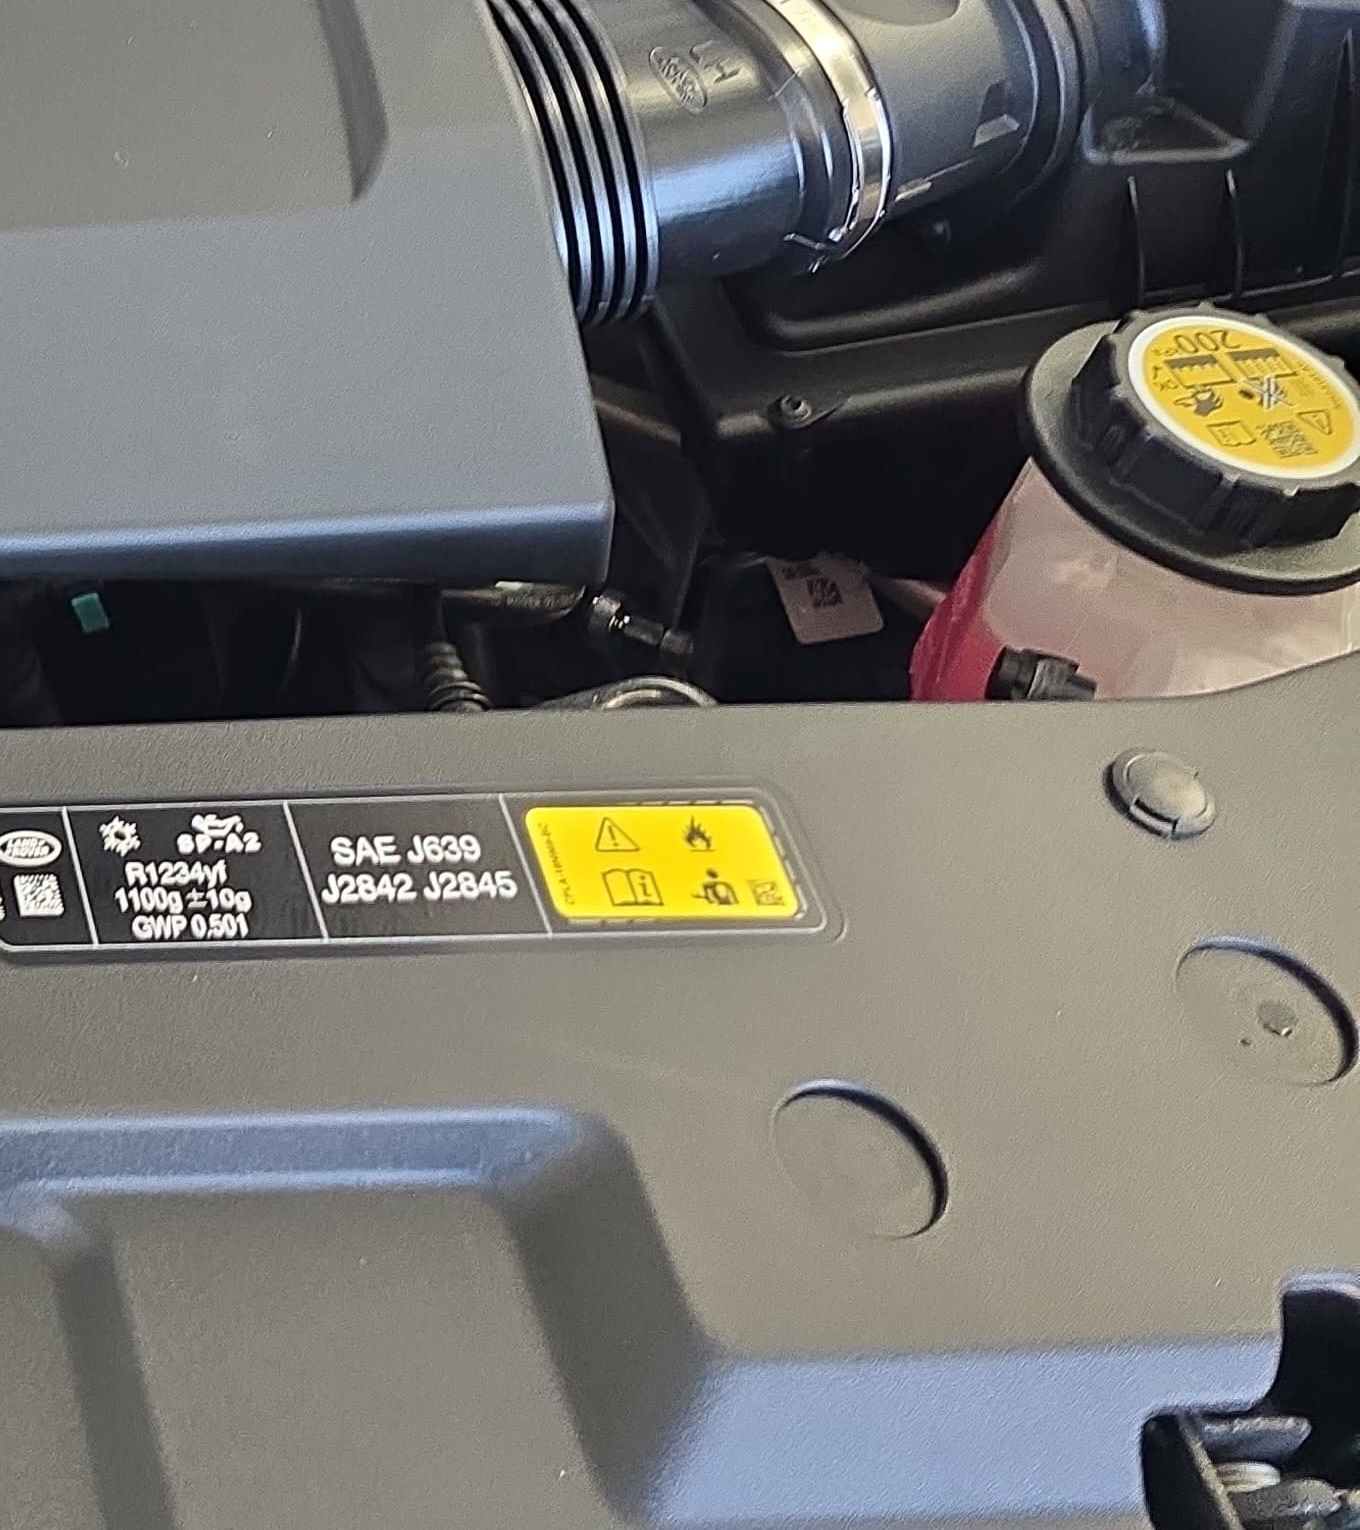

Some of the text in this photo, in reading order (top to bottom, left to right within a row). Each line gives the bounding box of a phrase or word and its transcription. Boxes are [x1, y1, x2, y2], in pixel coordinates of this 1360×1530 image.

[331, 835, 481, 865] SAE J639
[125, 860, 229, 887] R1234yf
[114, 887, 183, 914] 1100g
[322, 871, 517, 904] J2842 J2845
[131, 914, 186, 940] GWP
